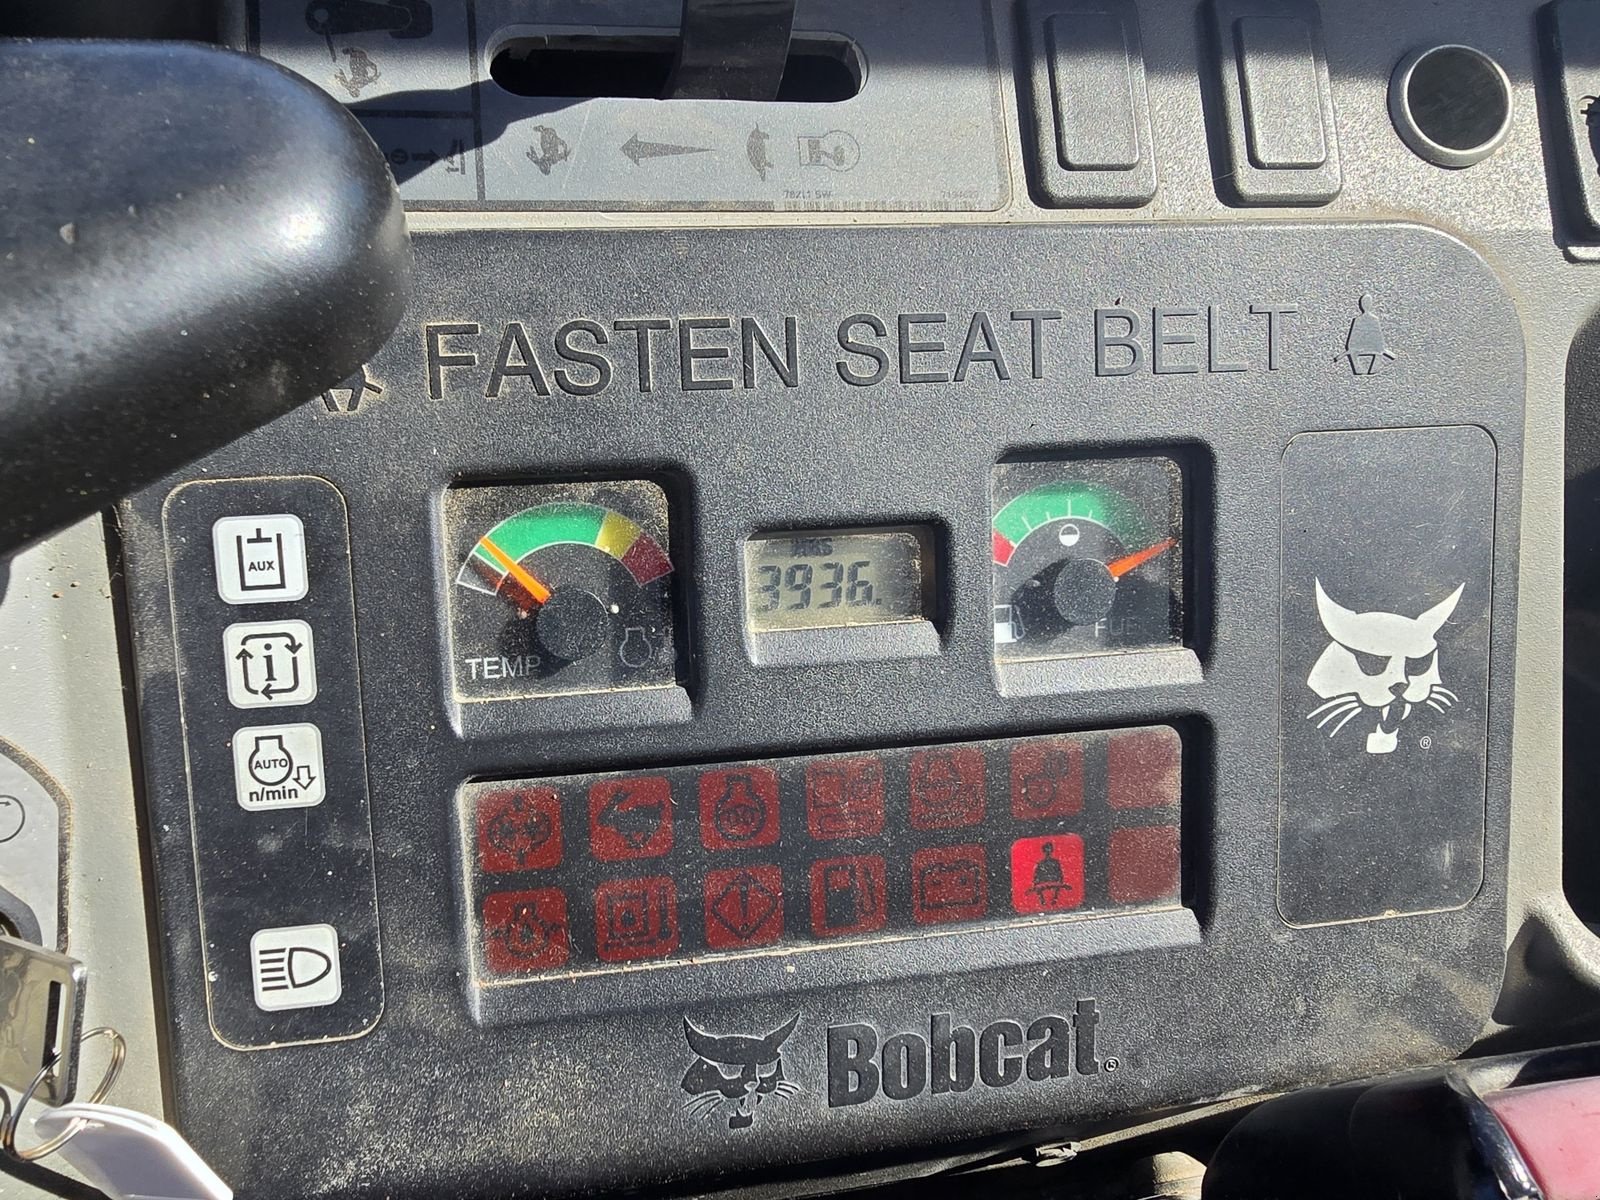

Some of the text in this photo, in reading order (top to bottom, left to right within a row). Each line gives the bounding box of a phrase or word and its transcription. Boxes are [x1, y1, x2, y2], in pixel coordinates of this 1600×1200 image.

[425, 304, 1298, 399] FASTEN SEAT BELT
[248, 561, 275, 572] AUX
[465, 655, 541, 680] TEMP
[254, 758, 288, 770] AUTO
[249, 785, 299, 802] n/min
[828, 998, 1099, 1108] Bobcat
